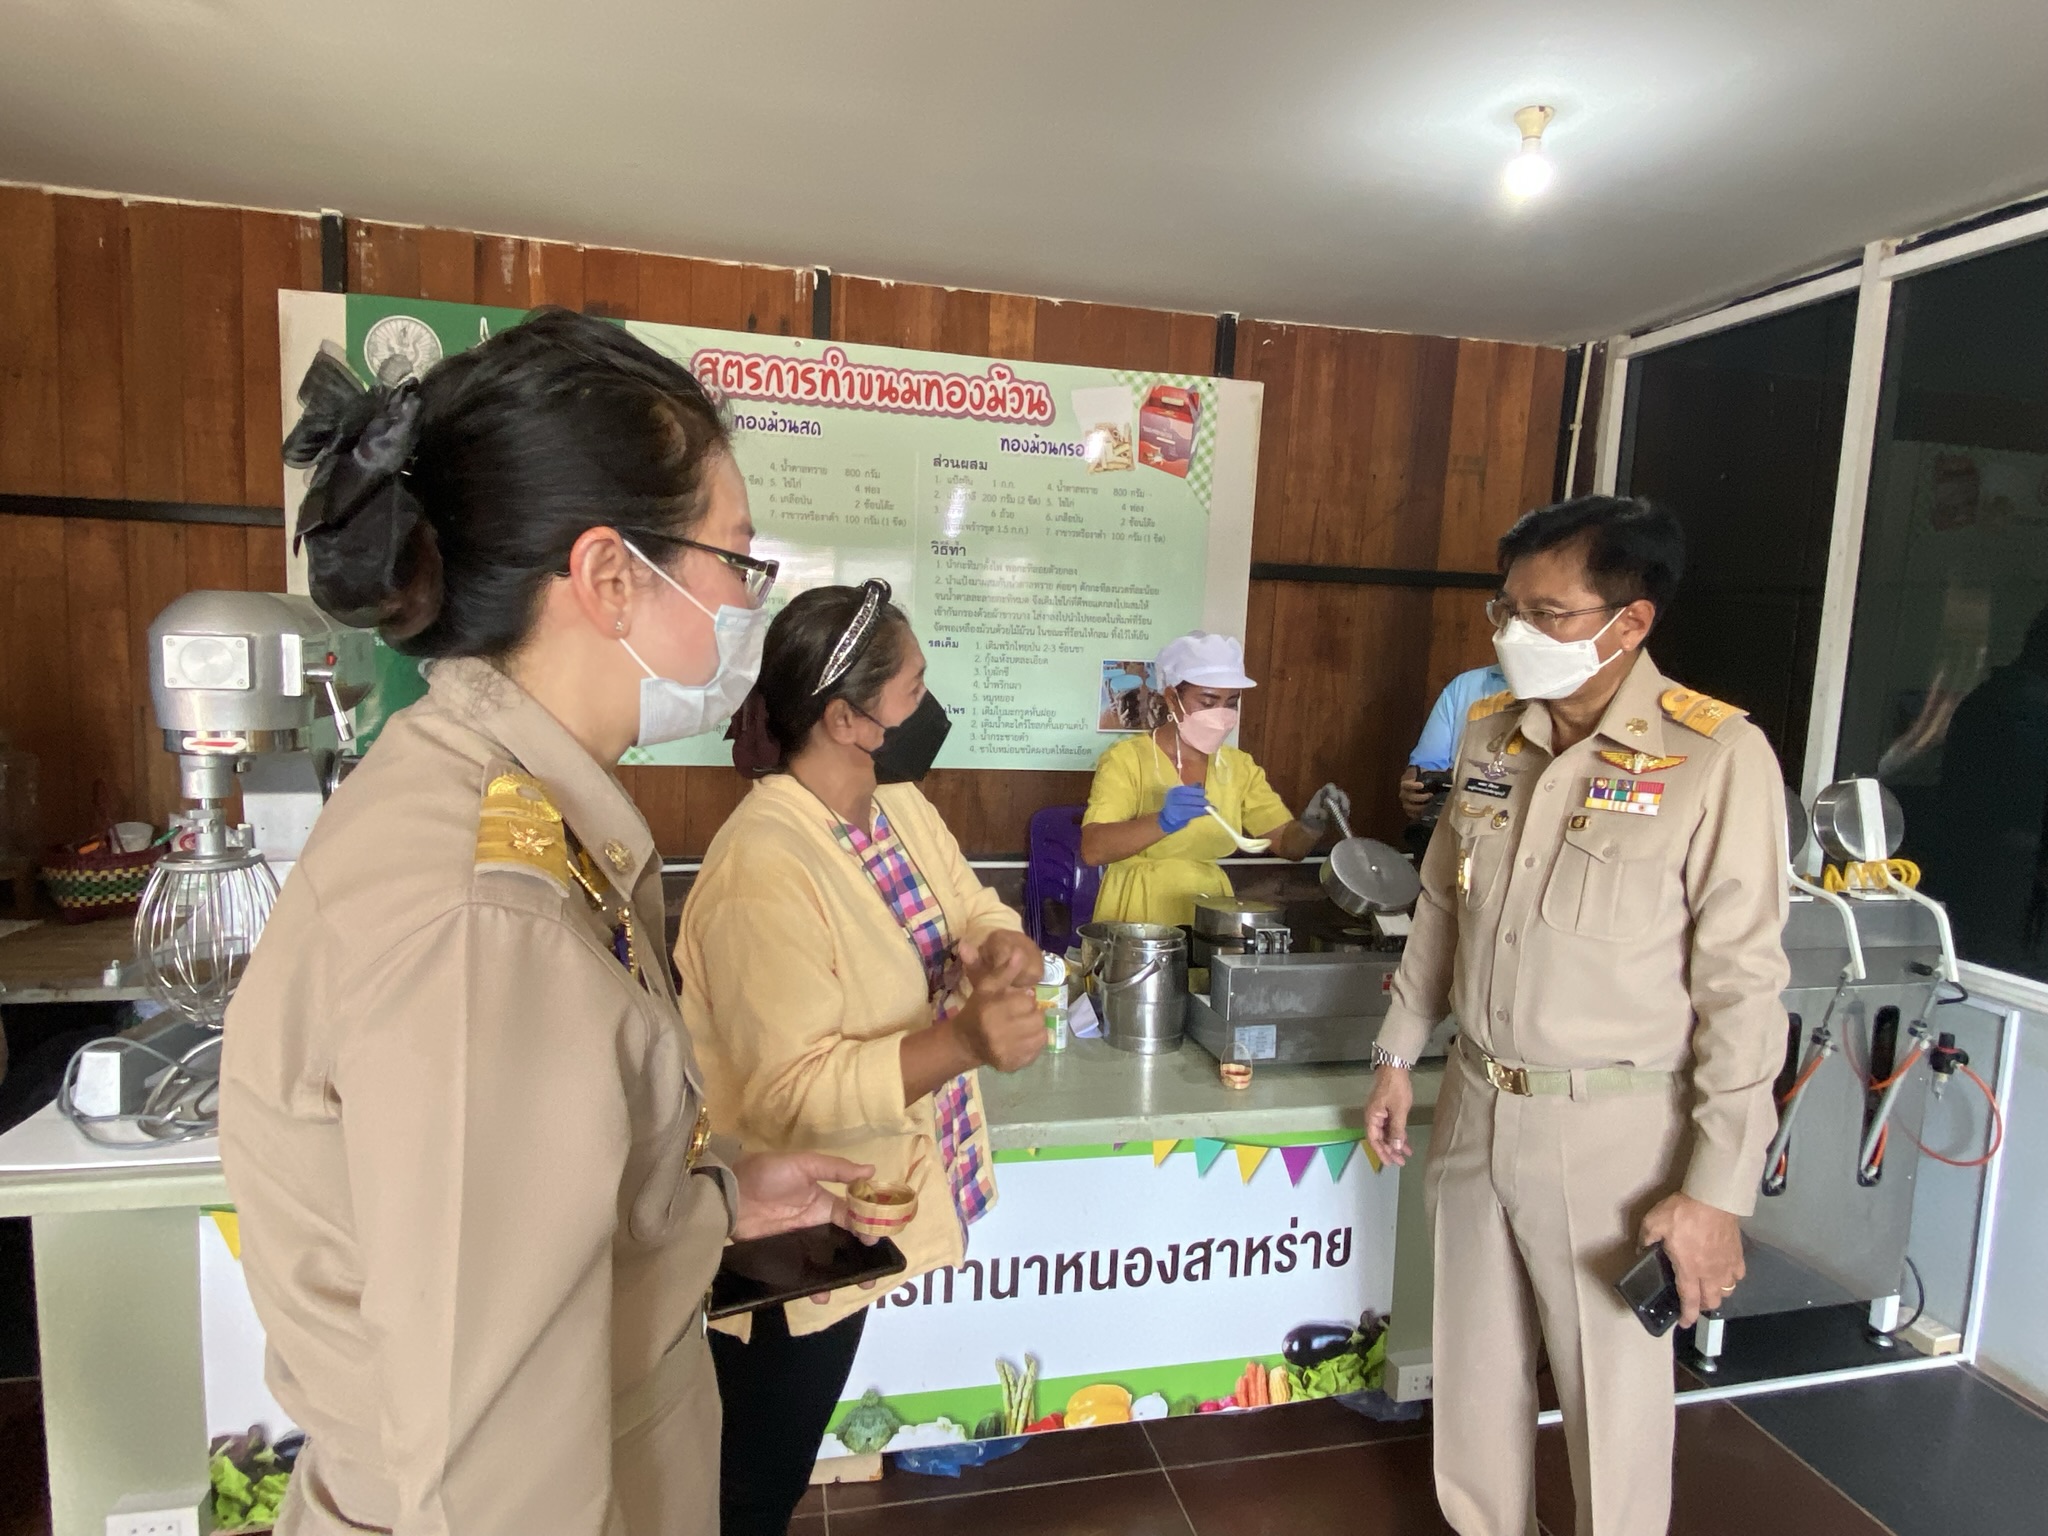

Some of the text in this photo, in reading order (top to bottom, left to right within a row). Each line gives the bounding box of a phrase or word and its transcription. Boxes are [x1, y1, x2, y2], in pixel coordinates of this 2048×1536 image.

[735, 410, 821, 436] ทองม้วนสด
[1000, 433, 1090, 457] ทองม้วนกรอ
[933, 454, 988, 471] ส่วนผสม
[930, 540, 967, 556] วิธีทำ
[928, 637, 959, 648] รสเค็ม
